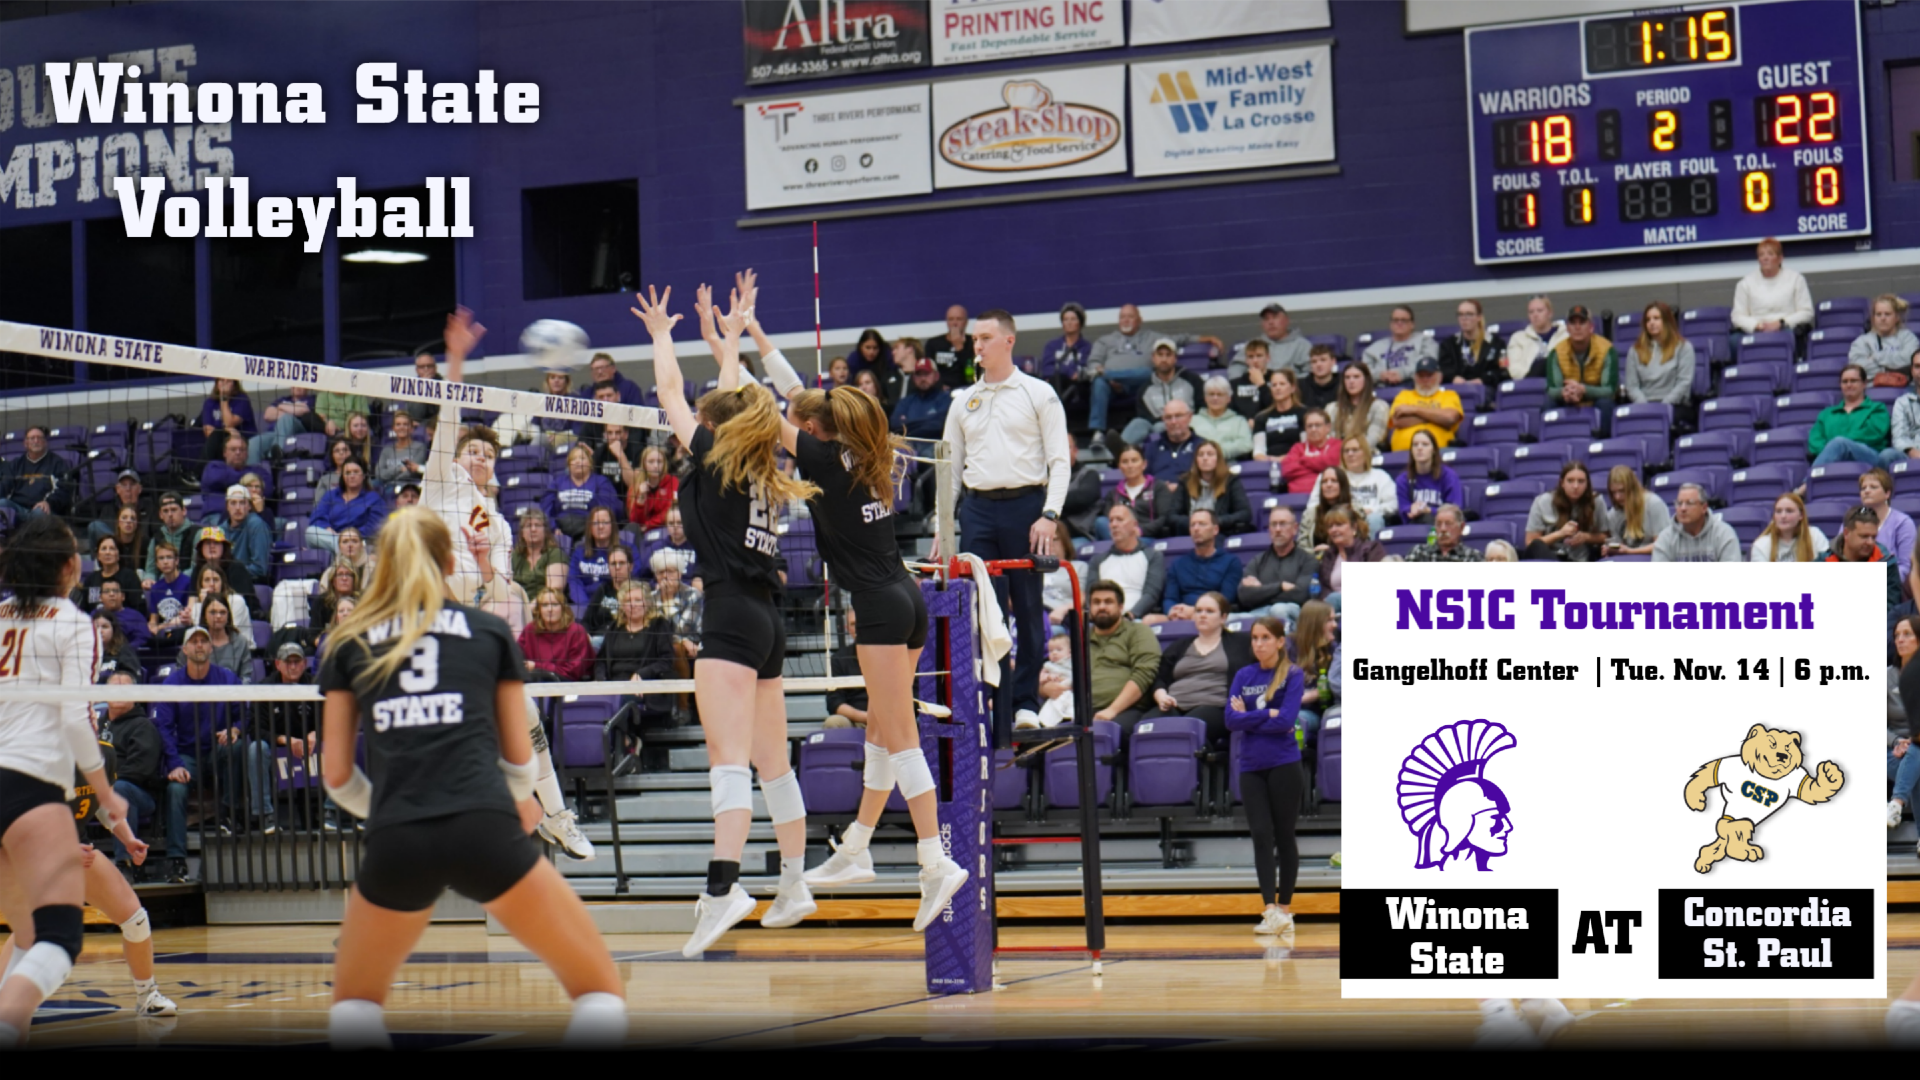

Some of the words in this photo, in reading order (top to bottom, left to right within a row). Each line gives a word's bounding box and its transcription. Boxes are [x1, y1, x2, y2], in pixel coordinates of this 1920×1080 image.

[773, 0, 899, 50] Altra
[944, 6, 1055, 39] PRINTING
[1063, 0, 1104, 26] INC
[820, 43, 849, 55] Federal
[850, 41, 872, 52] Credit
[873, 39, 897, 50] Union
[950, 42, 978, 53] Fast
[980, 30, 1051, 49] Dependable
[1054, 29, 1097, 42] Service
[1642, 10, 1732, 64] 1:15
[752, 61, 829, 79] 507-454-3365
[841, 51, 921, 69] www.altra.org
[1206, 60, 1314, 88] Mid-West
[1757, 61, 1832, 90] GUEST
[1230, 84, 1305, 109] Family
[1479, 83, 1592, 115] WARRIORS
[1636, 87, 1691, 107] PERIOD
[812, 111, 837, 123] THREE
[837, 108, 866, 122] RIVERS
[866, 103, 922, 119] PERFORMANCE
[1223, 114, 1246, 130] La
[1250, 109, 1316, 128] Crosse
[1774, 92, 1836, 145] 22
[822, 138, 848, 149] HUMAN
[1529, 115, 1574, 165] 18
[1652, 110, 1677, 151] 2
[961, 147, 1010, 163] Catering
[1027, 143, 1054, 157] Food
[1056, 140, 1098, 154] Service
[1164, 147, 1195, 158] Digital
[1197, 144, 1246, 156] Marketing
[1247, 141, 1273, 151] Made
[1275, 139, 1300, 150] Easy
[1734, 153, 1777, 172] T.O.L.
[1793, 146, 1844, 167] FOULS
[1493, 172, 1541, 191] FOULS
[1557, 168, 1599, 186] T.O.L.
[1614, 161, 1672, 181] PLAYER
[1680, 157, 1719, 177] FOUL
[1744, 171, 1770, 212] 0
[1815, 166, 1839, 206] 0
[1643, 225, 1697, 245] MATCH
[1797, 213, 1848, 233] SCORE
[1496, 236, 1545, 256] SCORE
[40, 328, 107, 357] WINONA
[114, 338, 164, 364] STATE
[244, 355, 319, 384] WARRIORS
[390, 375, 442, 400] WINONA
[446, 382, 484, 404] STATE
[544, 395, 604, 418] WARRIORS
[744, 526, 778, 558] STAT
[367, 608, 472, 646] WINA
[0, 627, 28, 678] 21
[399, 634, 440, 694] 3
[372, 692, 464, 734] STATE
[74, 798, 91, 820] 3
